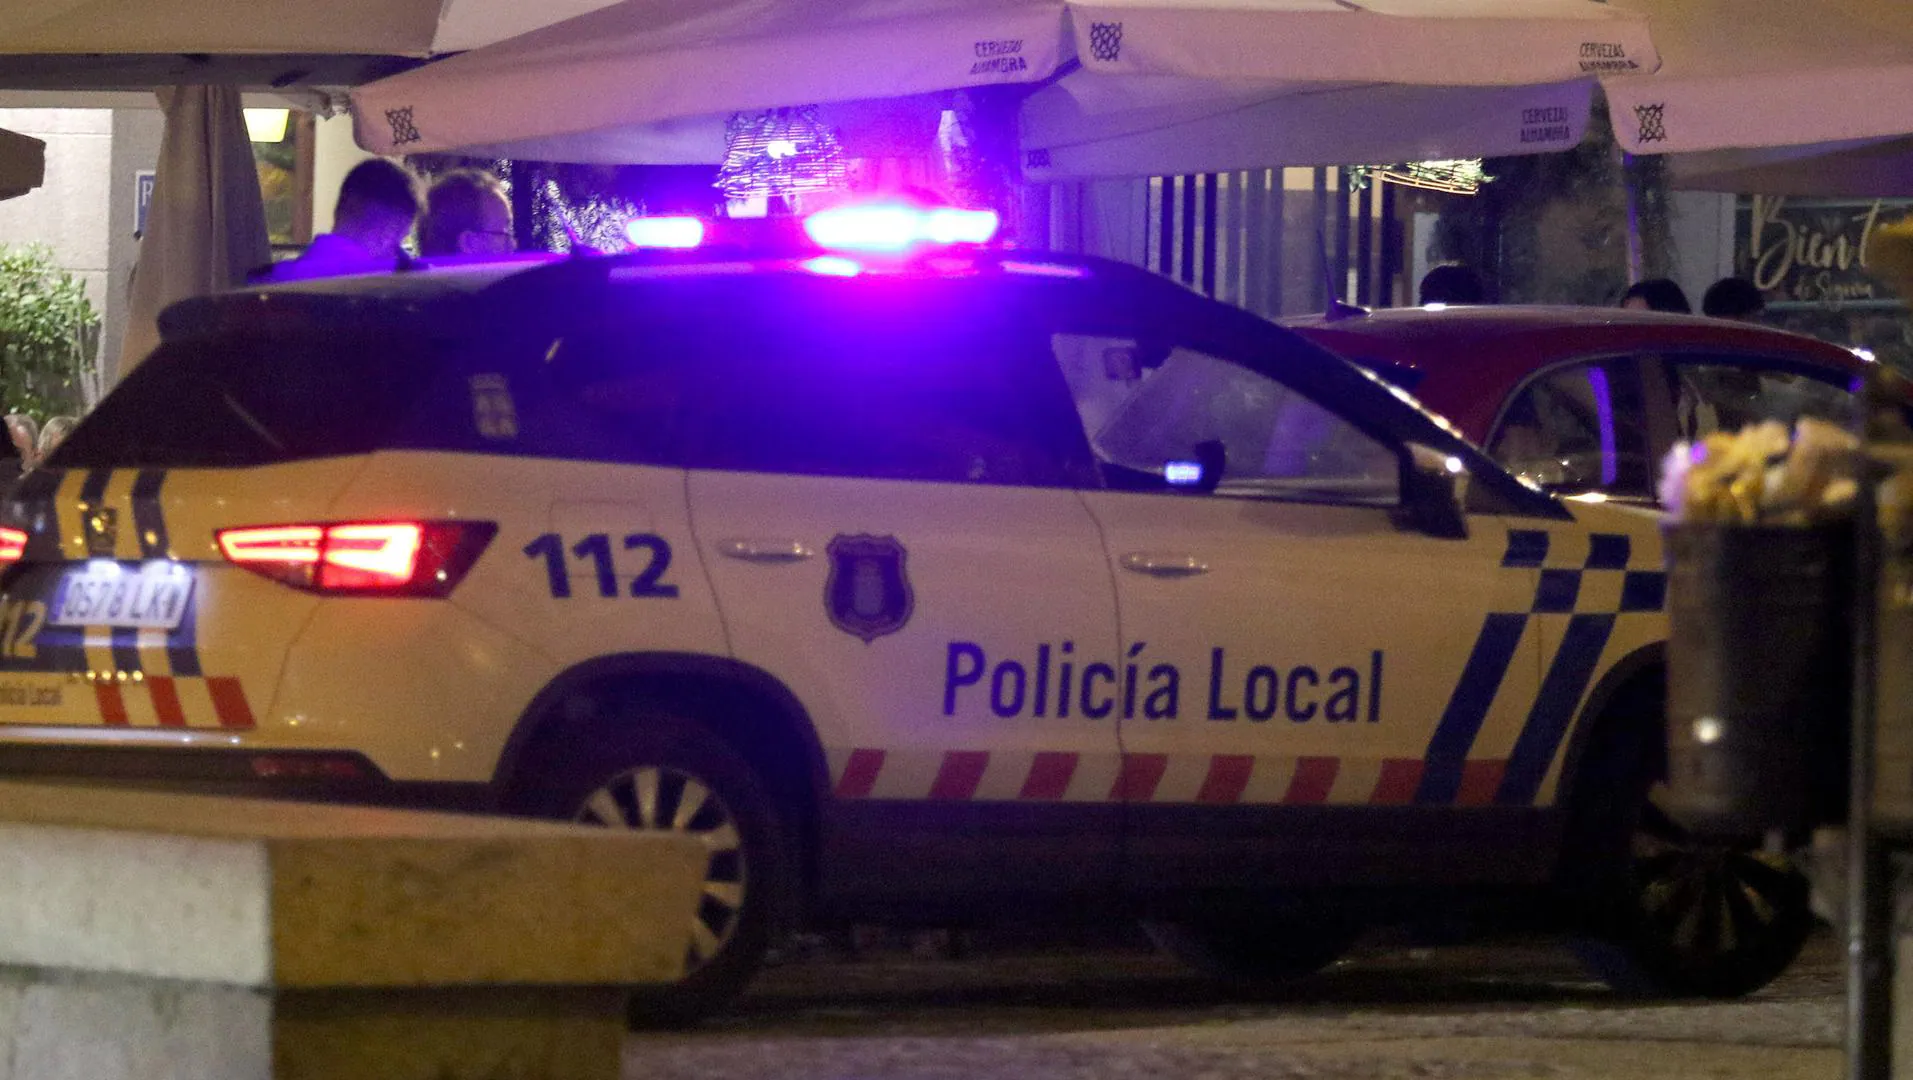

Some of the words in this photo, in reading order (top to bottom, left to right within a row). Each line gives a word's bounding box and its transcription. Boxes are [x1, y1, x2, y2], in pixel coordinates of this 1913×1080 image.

[1579, 42, 1625, 58] CERVEZAS
[522, 532, 680, 599] 112
[943, 640, 1180, 720] Policía
[1207, 646, 1384, 724] Local
